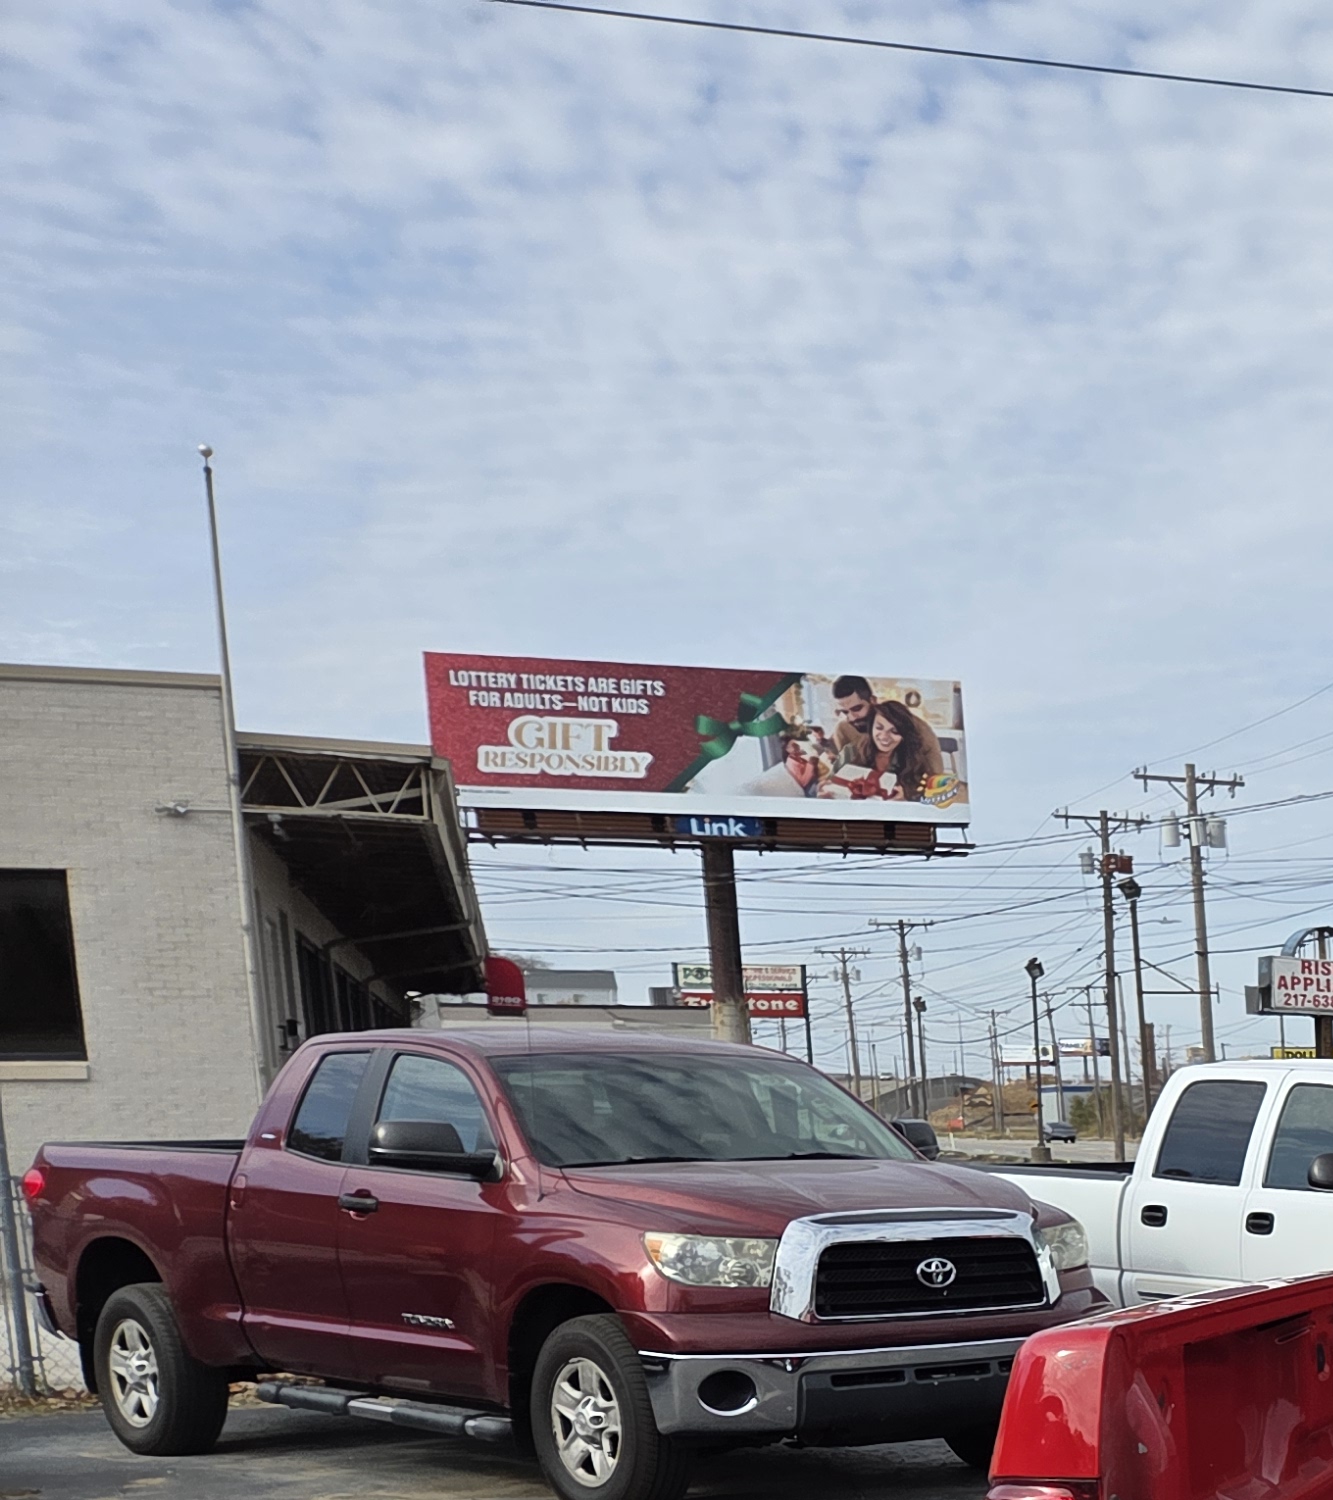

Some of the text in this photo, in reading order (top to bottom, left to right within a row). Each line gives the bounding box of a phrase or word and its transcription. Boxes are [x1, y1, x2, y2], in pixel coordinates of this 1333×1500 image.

[449, 670, 666, 697] LOTTERY TICKETS ARE GIFTS
[469, 690, 501, 707] FOR
[611, 698, 651, 715] KIDS
[513, 719, 614, 752] GIFT
[484, 750, 645, 774] RESPONSIBLY
[690, 817, 749, 837] Link
